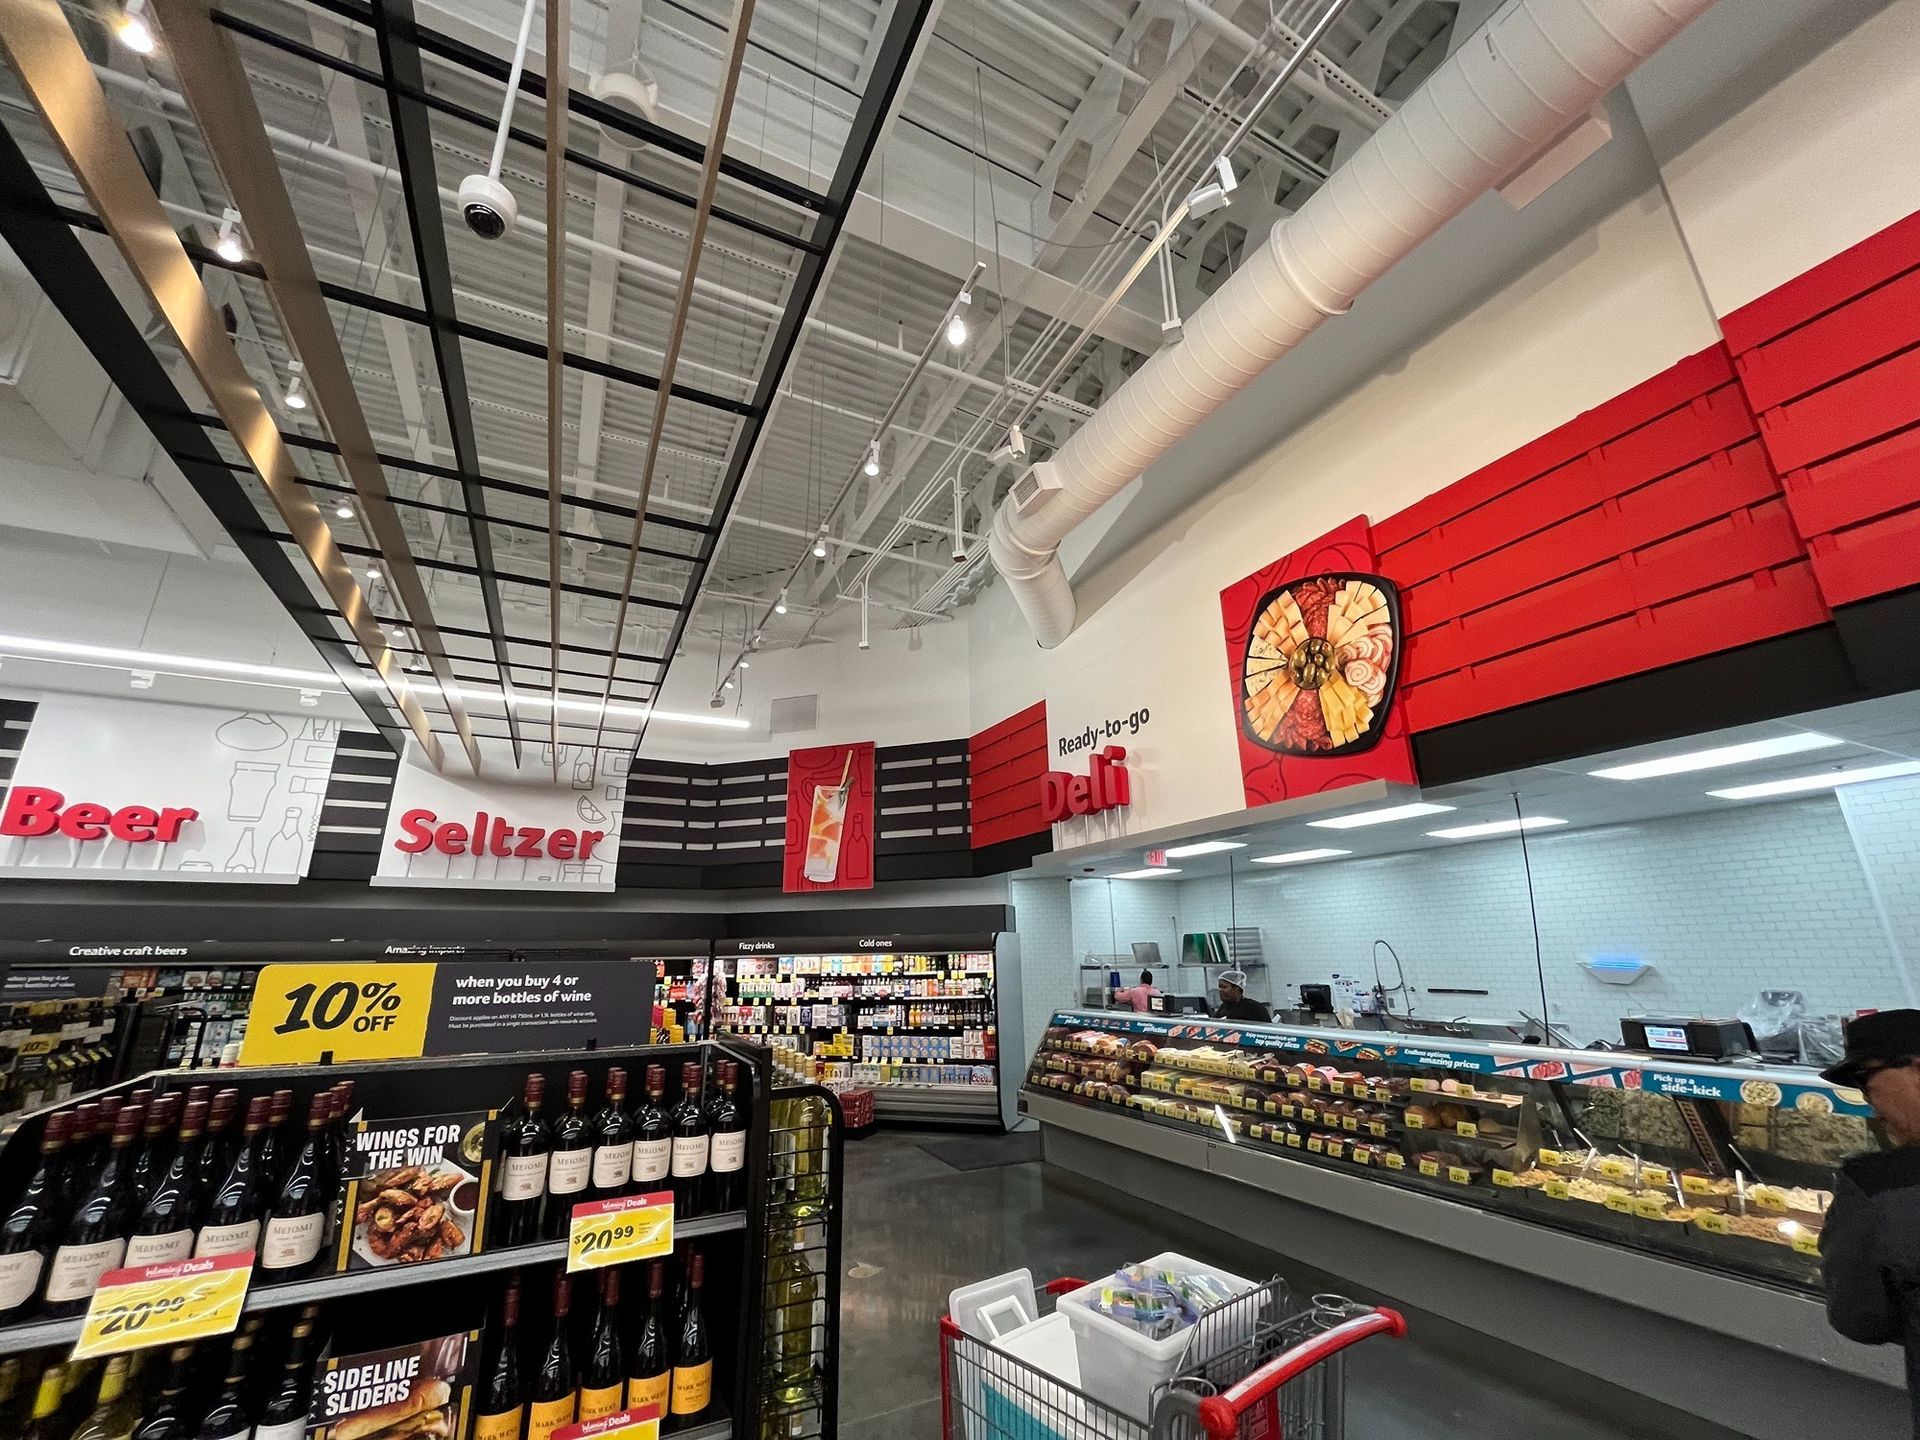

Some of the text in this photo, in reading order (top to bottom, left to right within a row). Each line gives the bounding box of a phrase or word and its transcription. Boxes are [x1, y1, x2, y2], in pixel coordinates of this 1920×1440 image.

[1058, 707, 1151, 757] Ready-to-go
[1040, 745, 1130, 824] Deli
[0, 786, 199, 842] Beer
[394, 808, 604, 859] Seltzer
[69, 946, 188, 956] Creative craft beers
[738, 942, 775, 951] Fizzy drinks
[859, 939, 875, 948] Cold
[456, 974, 579, 991] when you buy 4 or
[452, 990, 592, 1006] more bottles of wine
[273, 981, 401, 1035] 10%
[353, 1015, 397, 1033] OFF
[1419, 1057, 1480, 1070] amazing prices
[1653, 1073, 1673, 1083] Pick
[1674, 1077, 1687, 1085] up
[1661, 1082, 1721, 1097] side-kick
[356, 1124, 461, 1152] WINGS FOR
[368, 1145, 443, 1170] THE WIN
[626, 1197, 647, 1208] Deals
[183, 1259, 214, 1273] Deals
[323, 1355, 421, 1394] SIDELINE
[325, 1379, 411, 1417] SLIDERS
[608, 1413, 631, 1427] Deals
